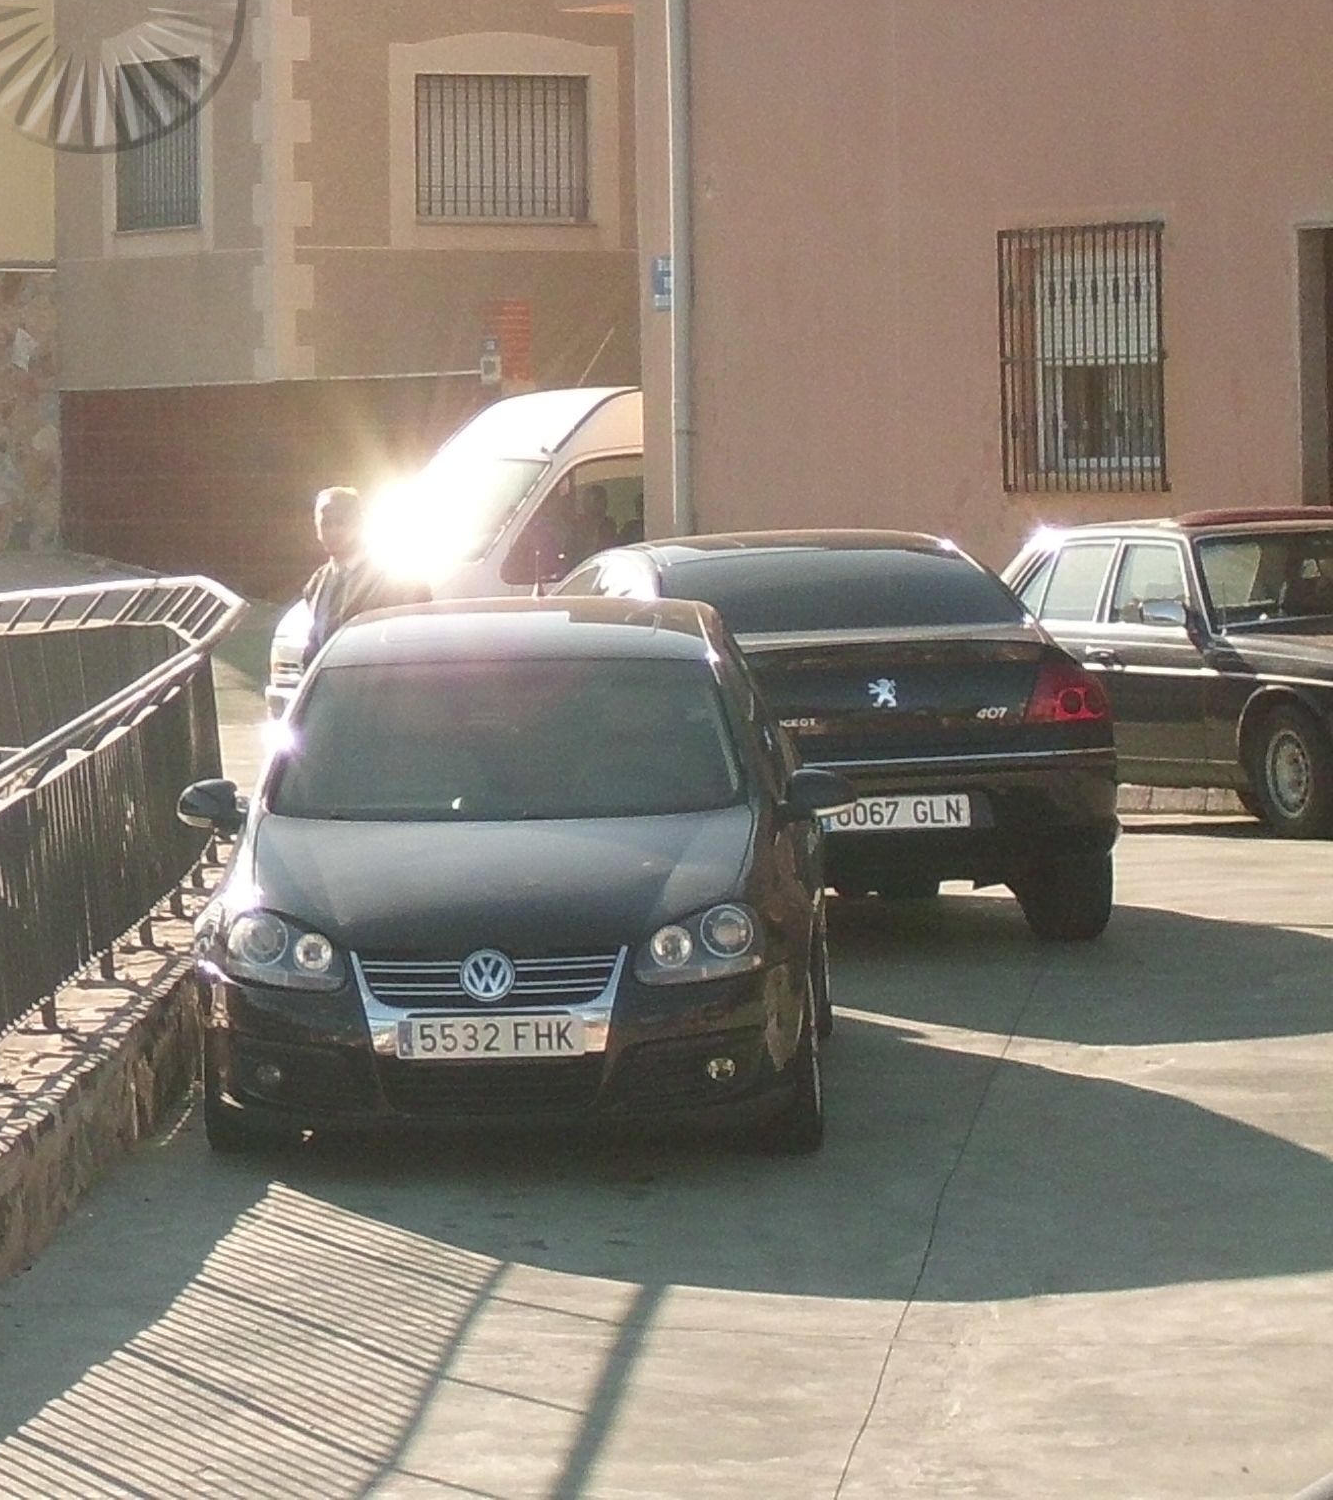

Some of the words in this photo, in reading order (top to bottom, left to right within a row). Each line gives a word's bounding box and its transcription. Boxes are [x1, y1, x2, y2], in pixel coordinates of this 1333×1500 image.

[976, 706, 1008, 719] 407
[836, 801, 900, 826] 0067
[913, 799, 962, 824] GLN
[418, 1022, 501, 1052] 5532
[513, 1020, 575, 1050] FHK
